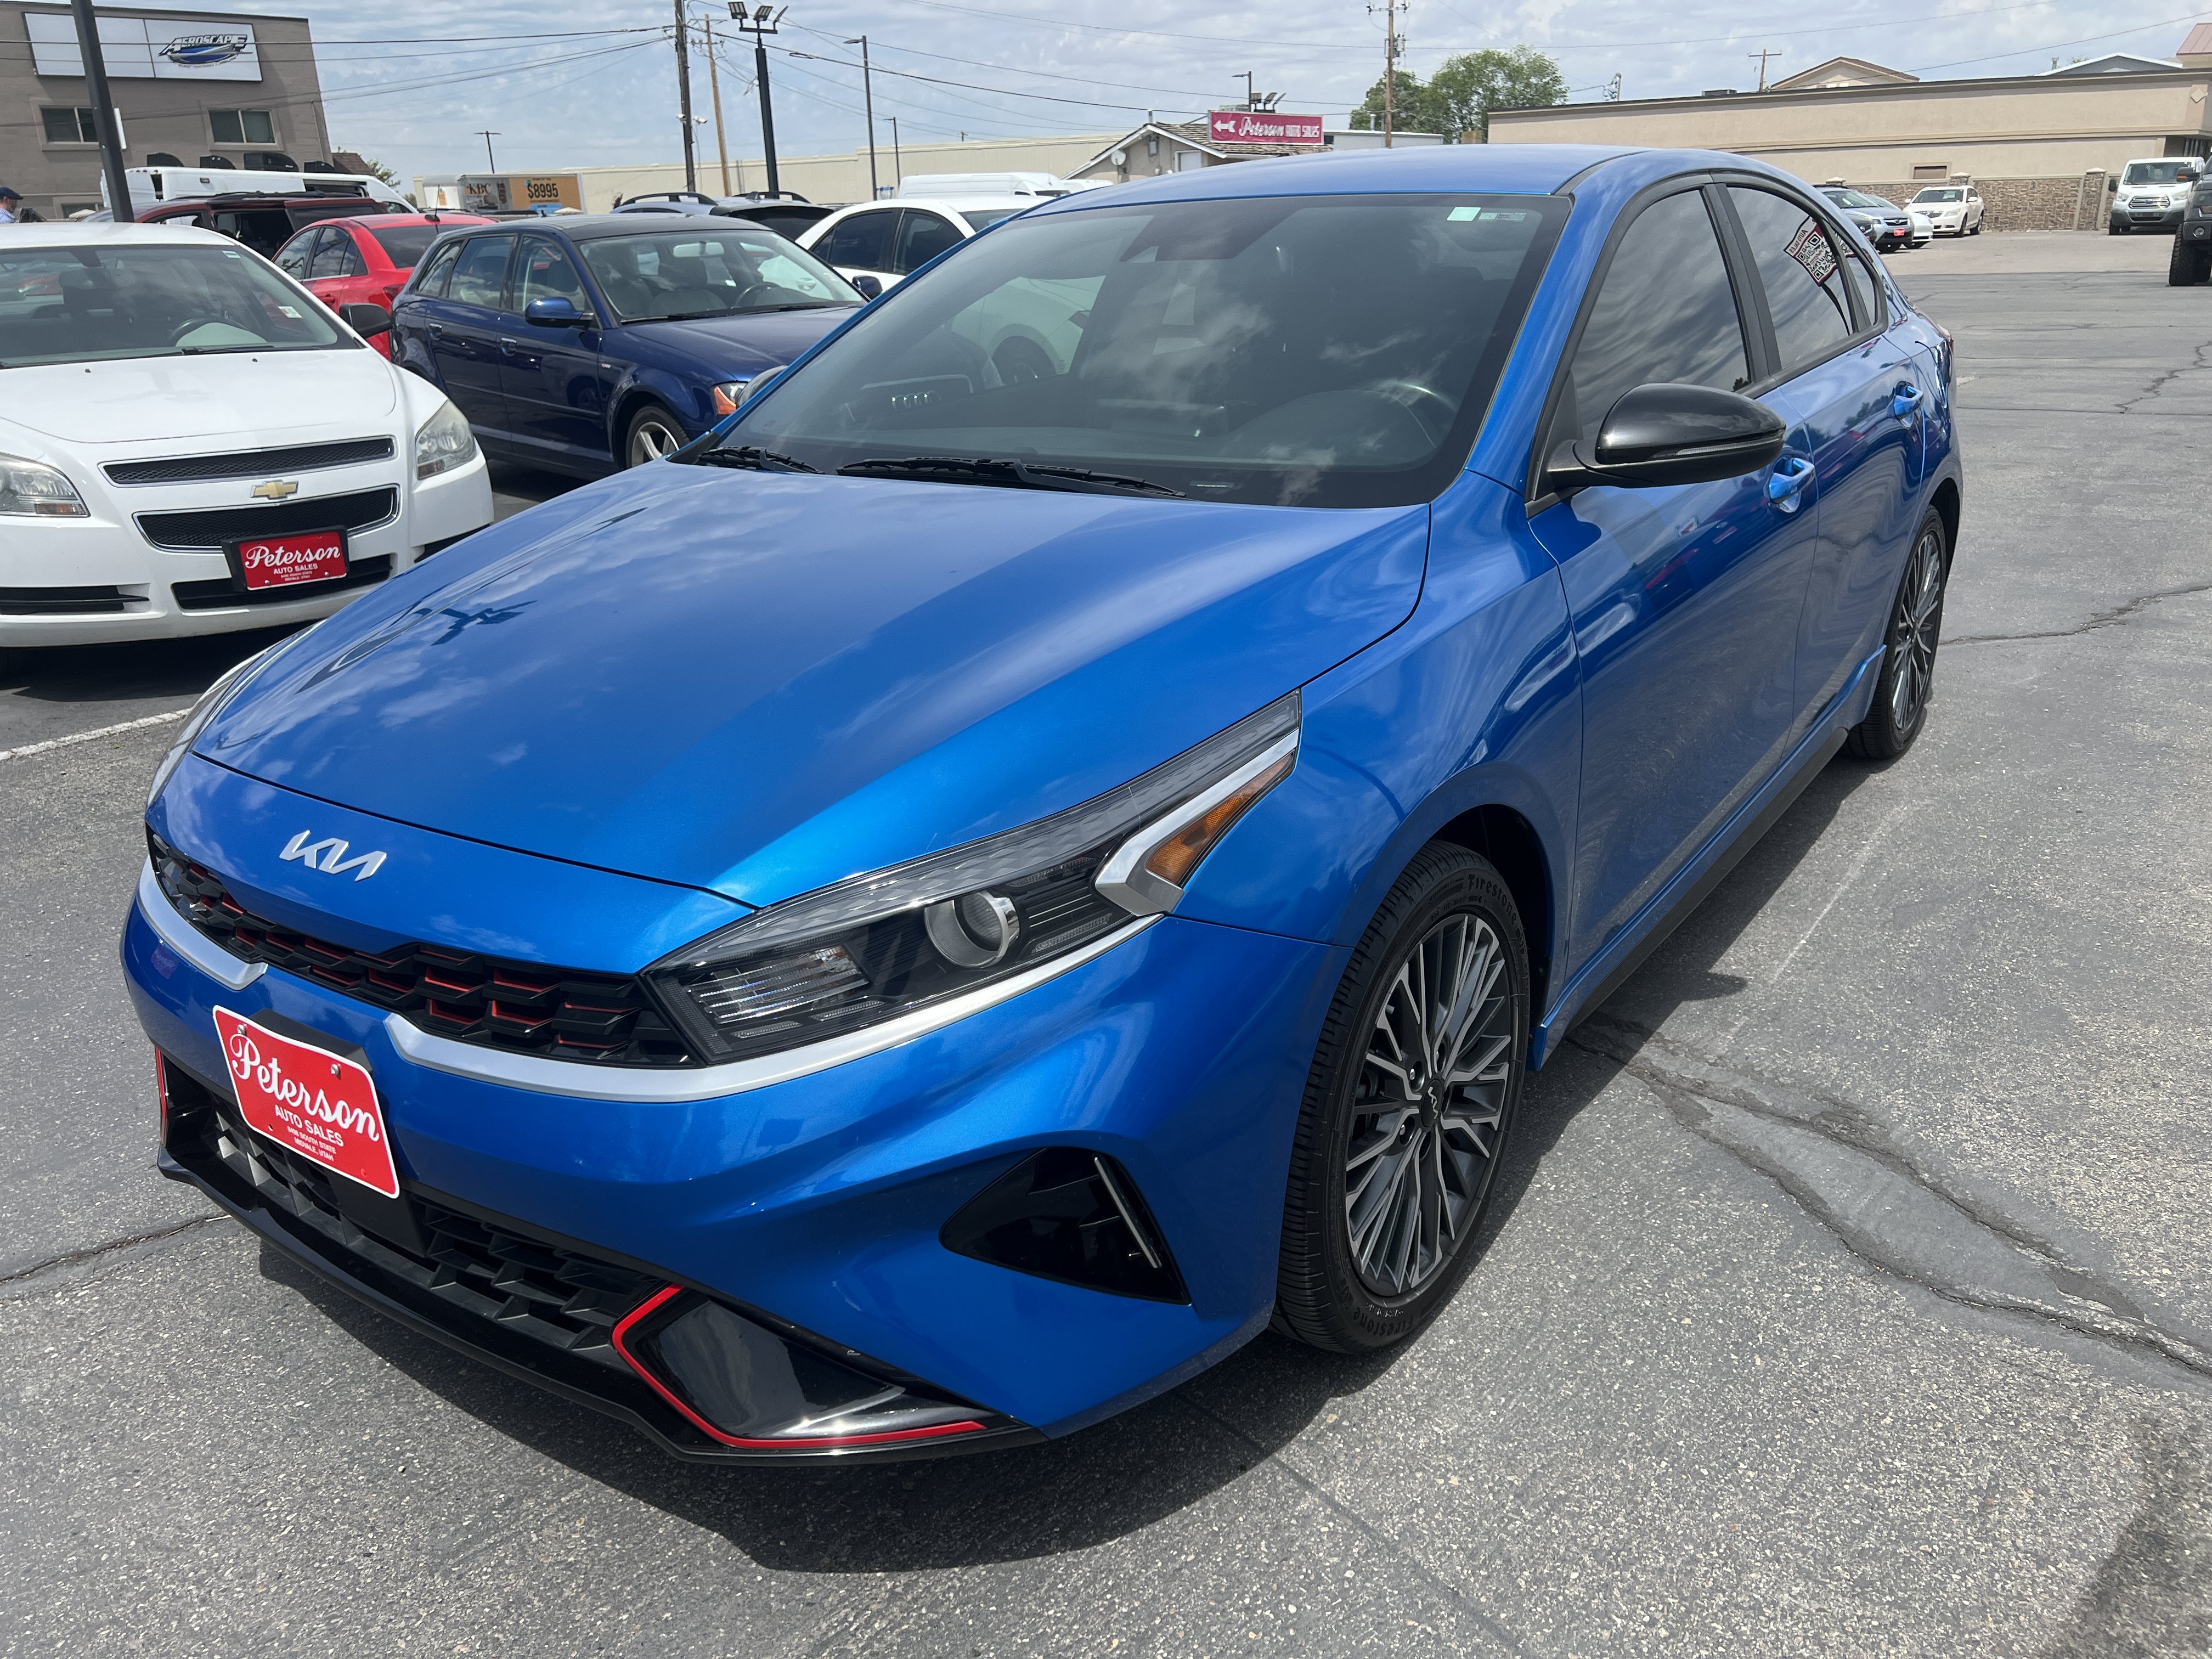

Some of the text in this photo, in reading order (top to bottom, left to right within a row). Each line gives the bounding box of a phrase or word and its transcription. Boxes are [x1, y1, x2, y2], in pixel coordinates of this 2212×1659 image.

[158, 34, 247, 56] AEROSCAPE
[1238, 116, 1285, 137] Peterson
[469, 183, 492, 195] KBC
[527, 183, 558, 199] $8995
[245, 546, 340, 568] Peterson
[295, 563, 318, 572] SALES
[279, 830, 387, 882] KIA
[1468, 873, 1517, 926] Firestone
[230, 1034, 380, 1142] Peterson
[275, 1104, 344, 1147] AUTO SALES
[300, 1132, 319, 1146] SOUTH
[319, 1141, 337, 1154] STATE
[318, 1149, 334, 1161] UTAH
[1353, 1307, 1414, 1337] Firestone
